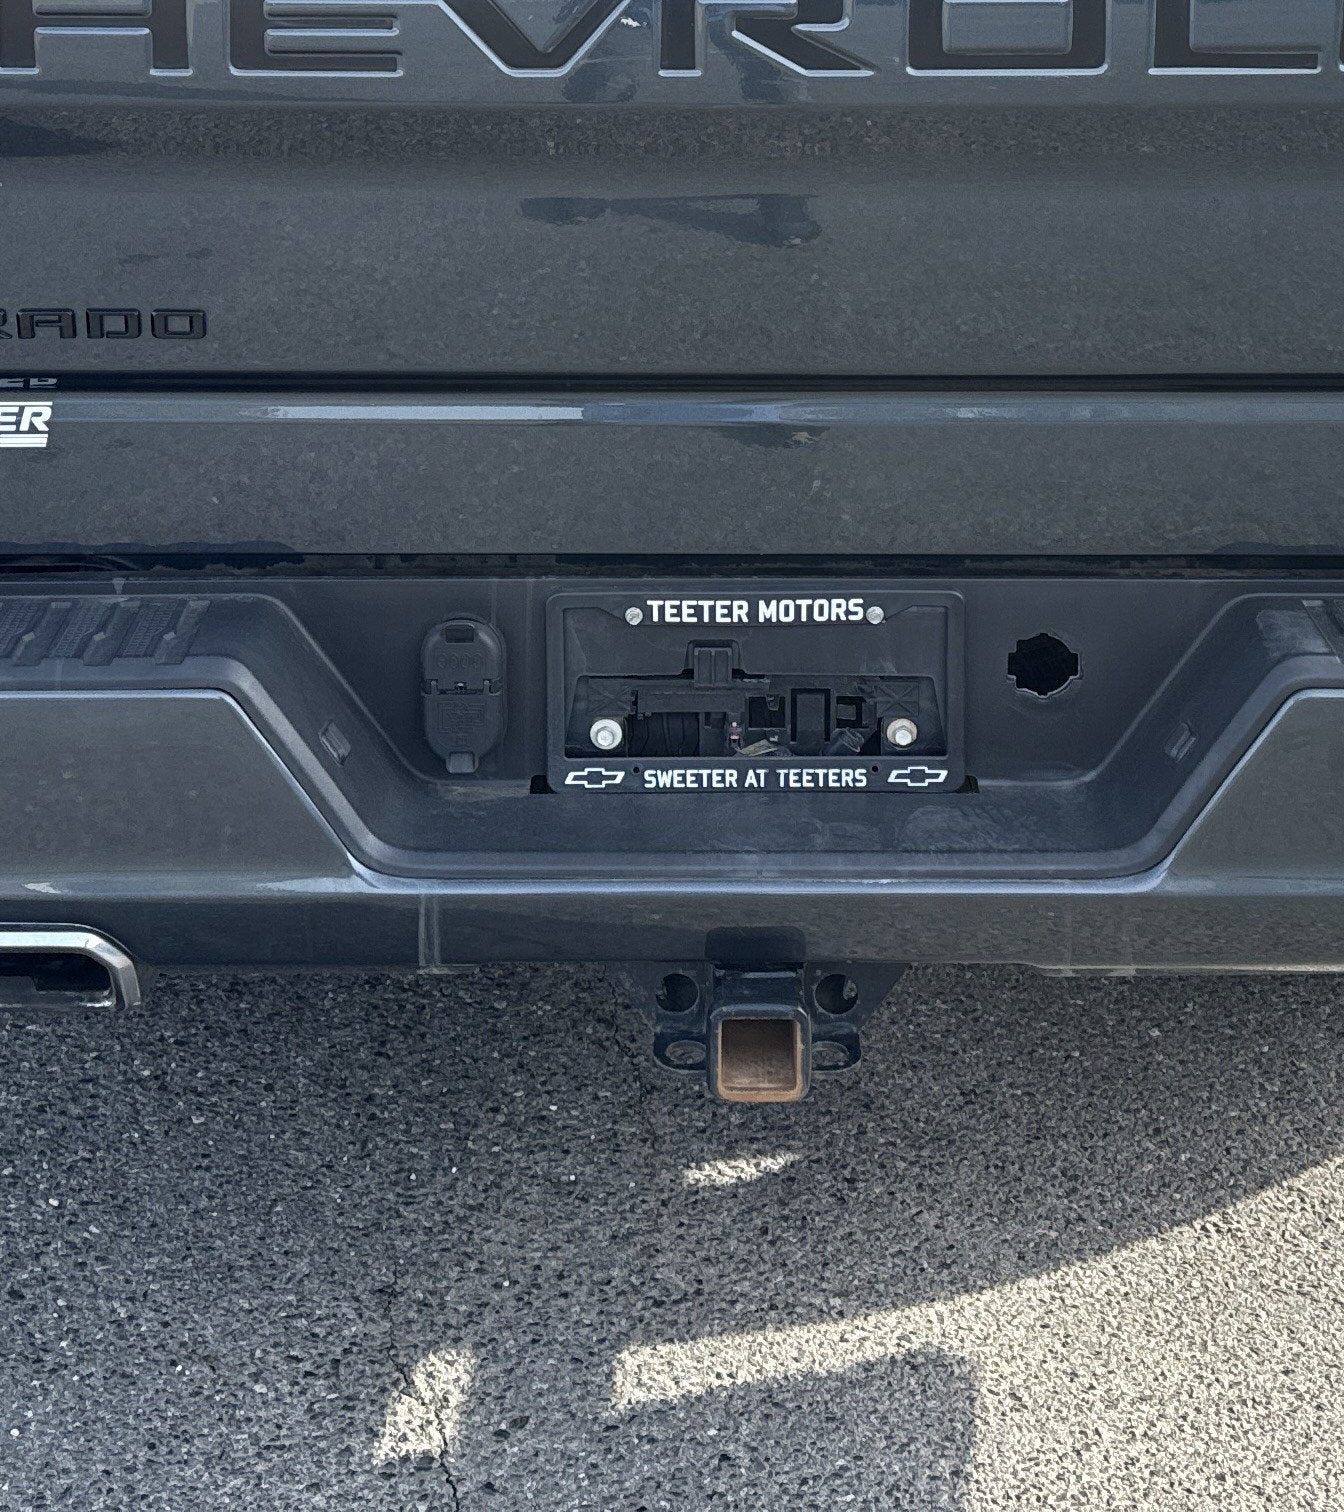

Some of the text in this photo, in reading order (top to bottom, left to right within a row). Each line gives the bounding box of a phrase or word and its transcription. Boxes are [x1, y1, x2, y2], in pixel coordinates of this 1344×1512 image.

[647, 598, 864, 623] TEETER MOTORS
[644, 768, 868, 788] SWEETER AT TEETERS
